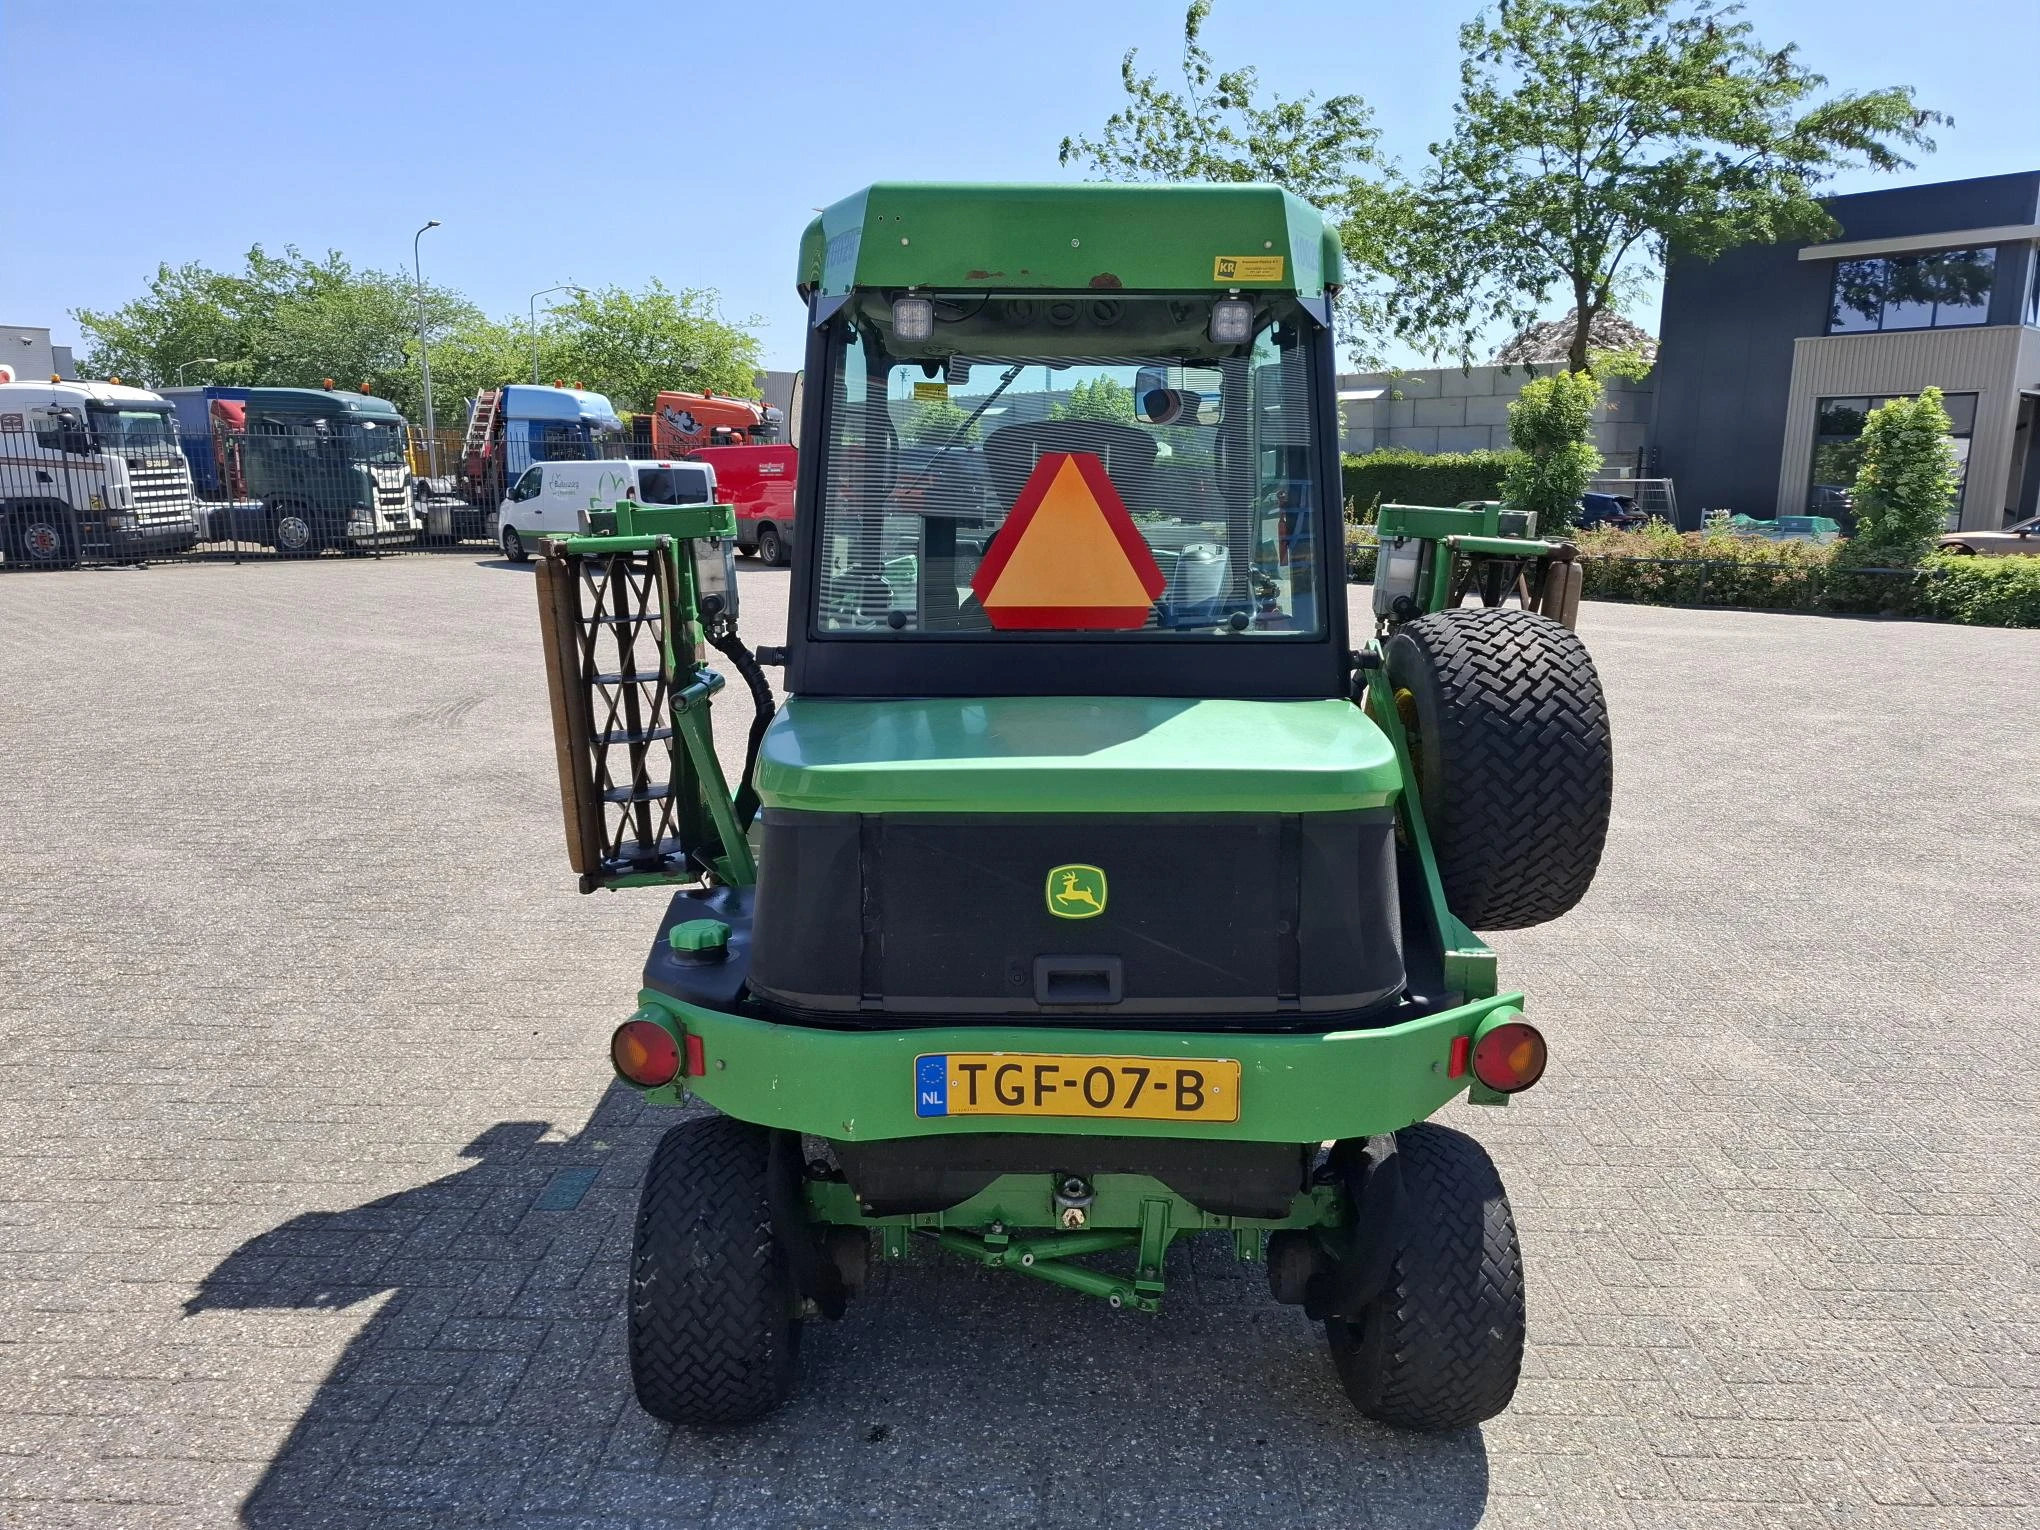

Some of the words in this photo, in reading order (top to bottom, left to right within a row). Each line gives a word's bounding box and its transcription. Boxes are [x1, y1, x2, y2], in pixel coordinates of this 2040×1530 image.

[1219, 262, 1235, 273] KR
[958, 1062, 1206, 1112] TGF-07-B
[922, 1091, 944, 1105] NL
